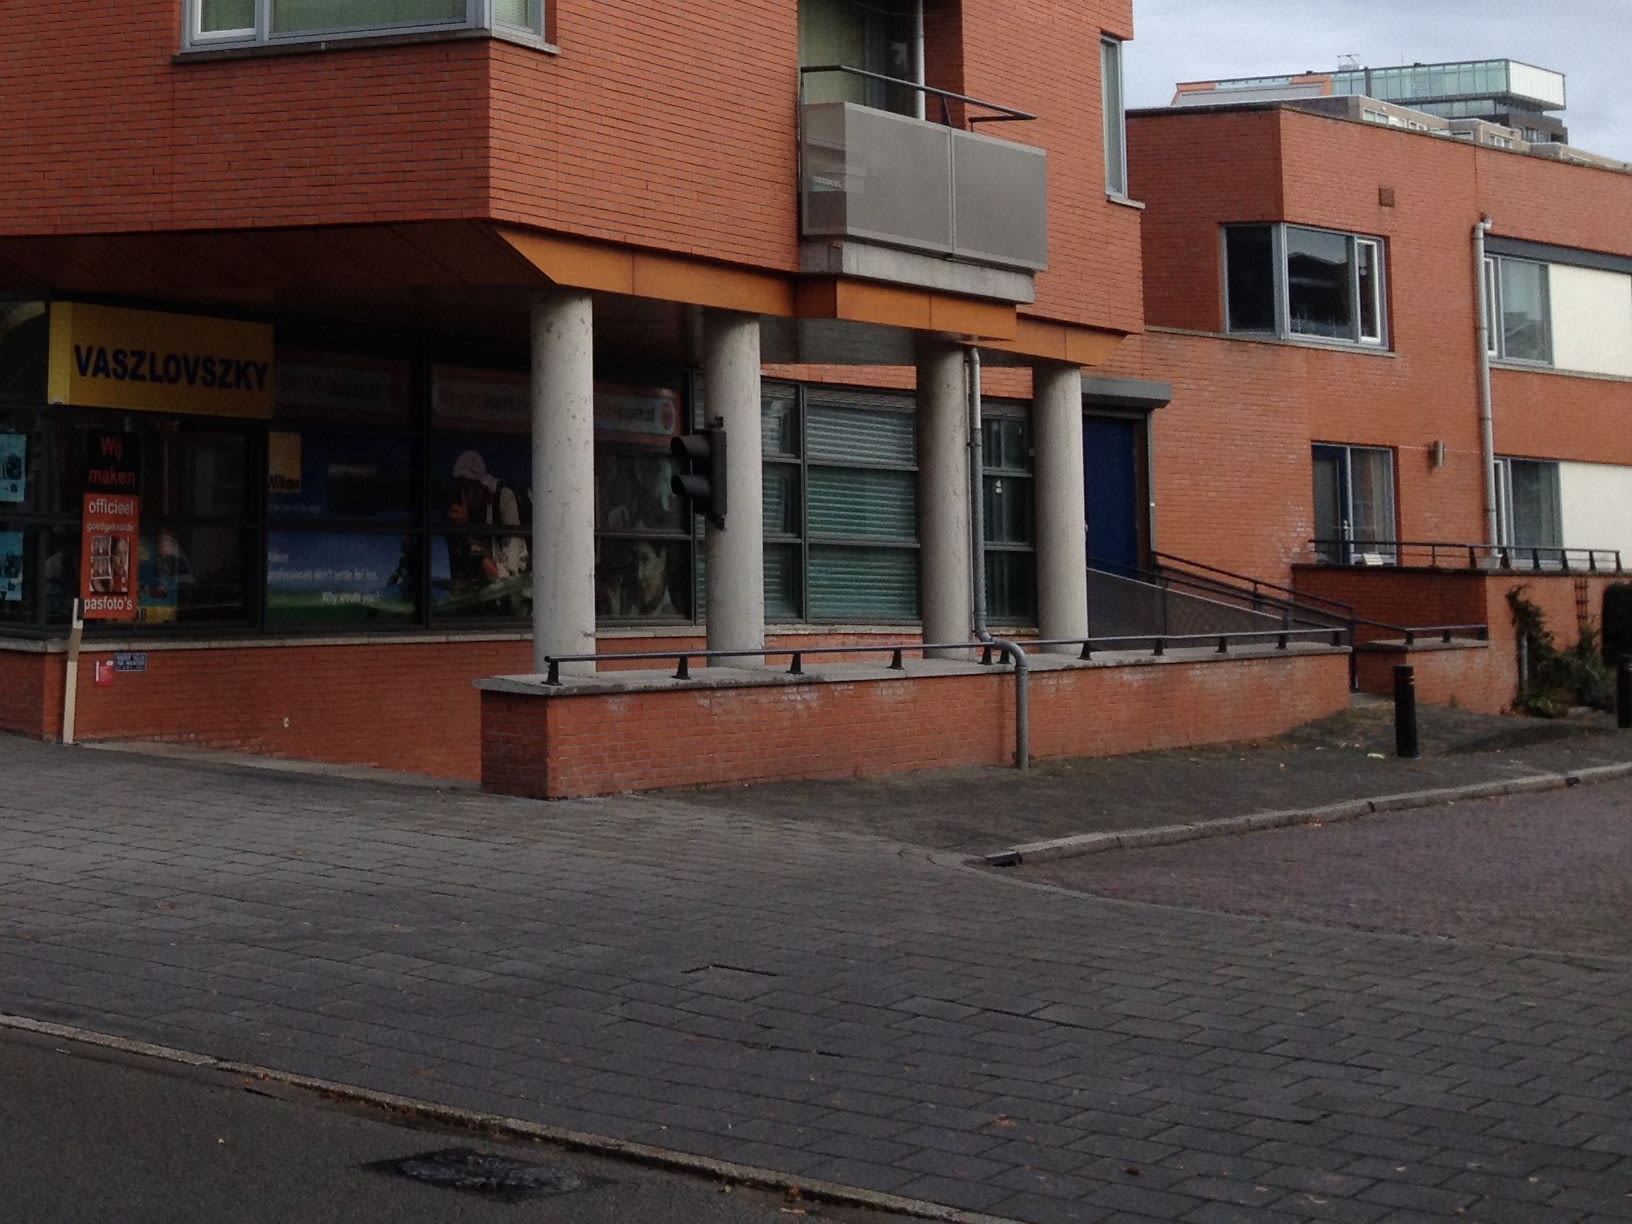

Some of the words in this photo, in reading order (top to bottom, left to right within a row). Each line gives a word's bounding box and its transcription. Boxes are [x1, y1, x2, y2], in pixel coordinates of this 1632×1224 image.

[74, 344, 268, 392] VASZLOVSZKY
[88, 498, 134, 515] officieel
[83, 596, 133, 613] pasfoto's
